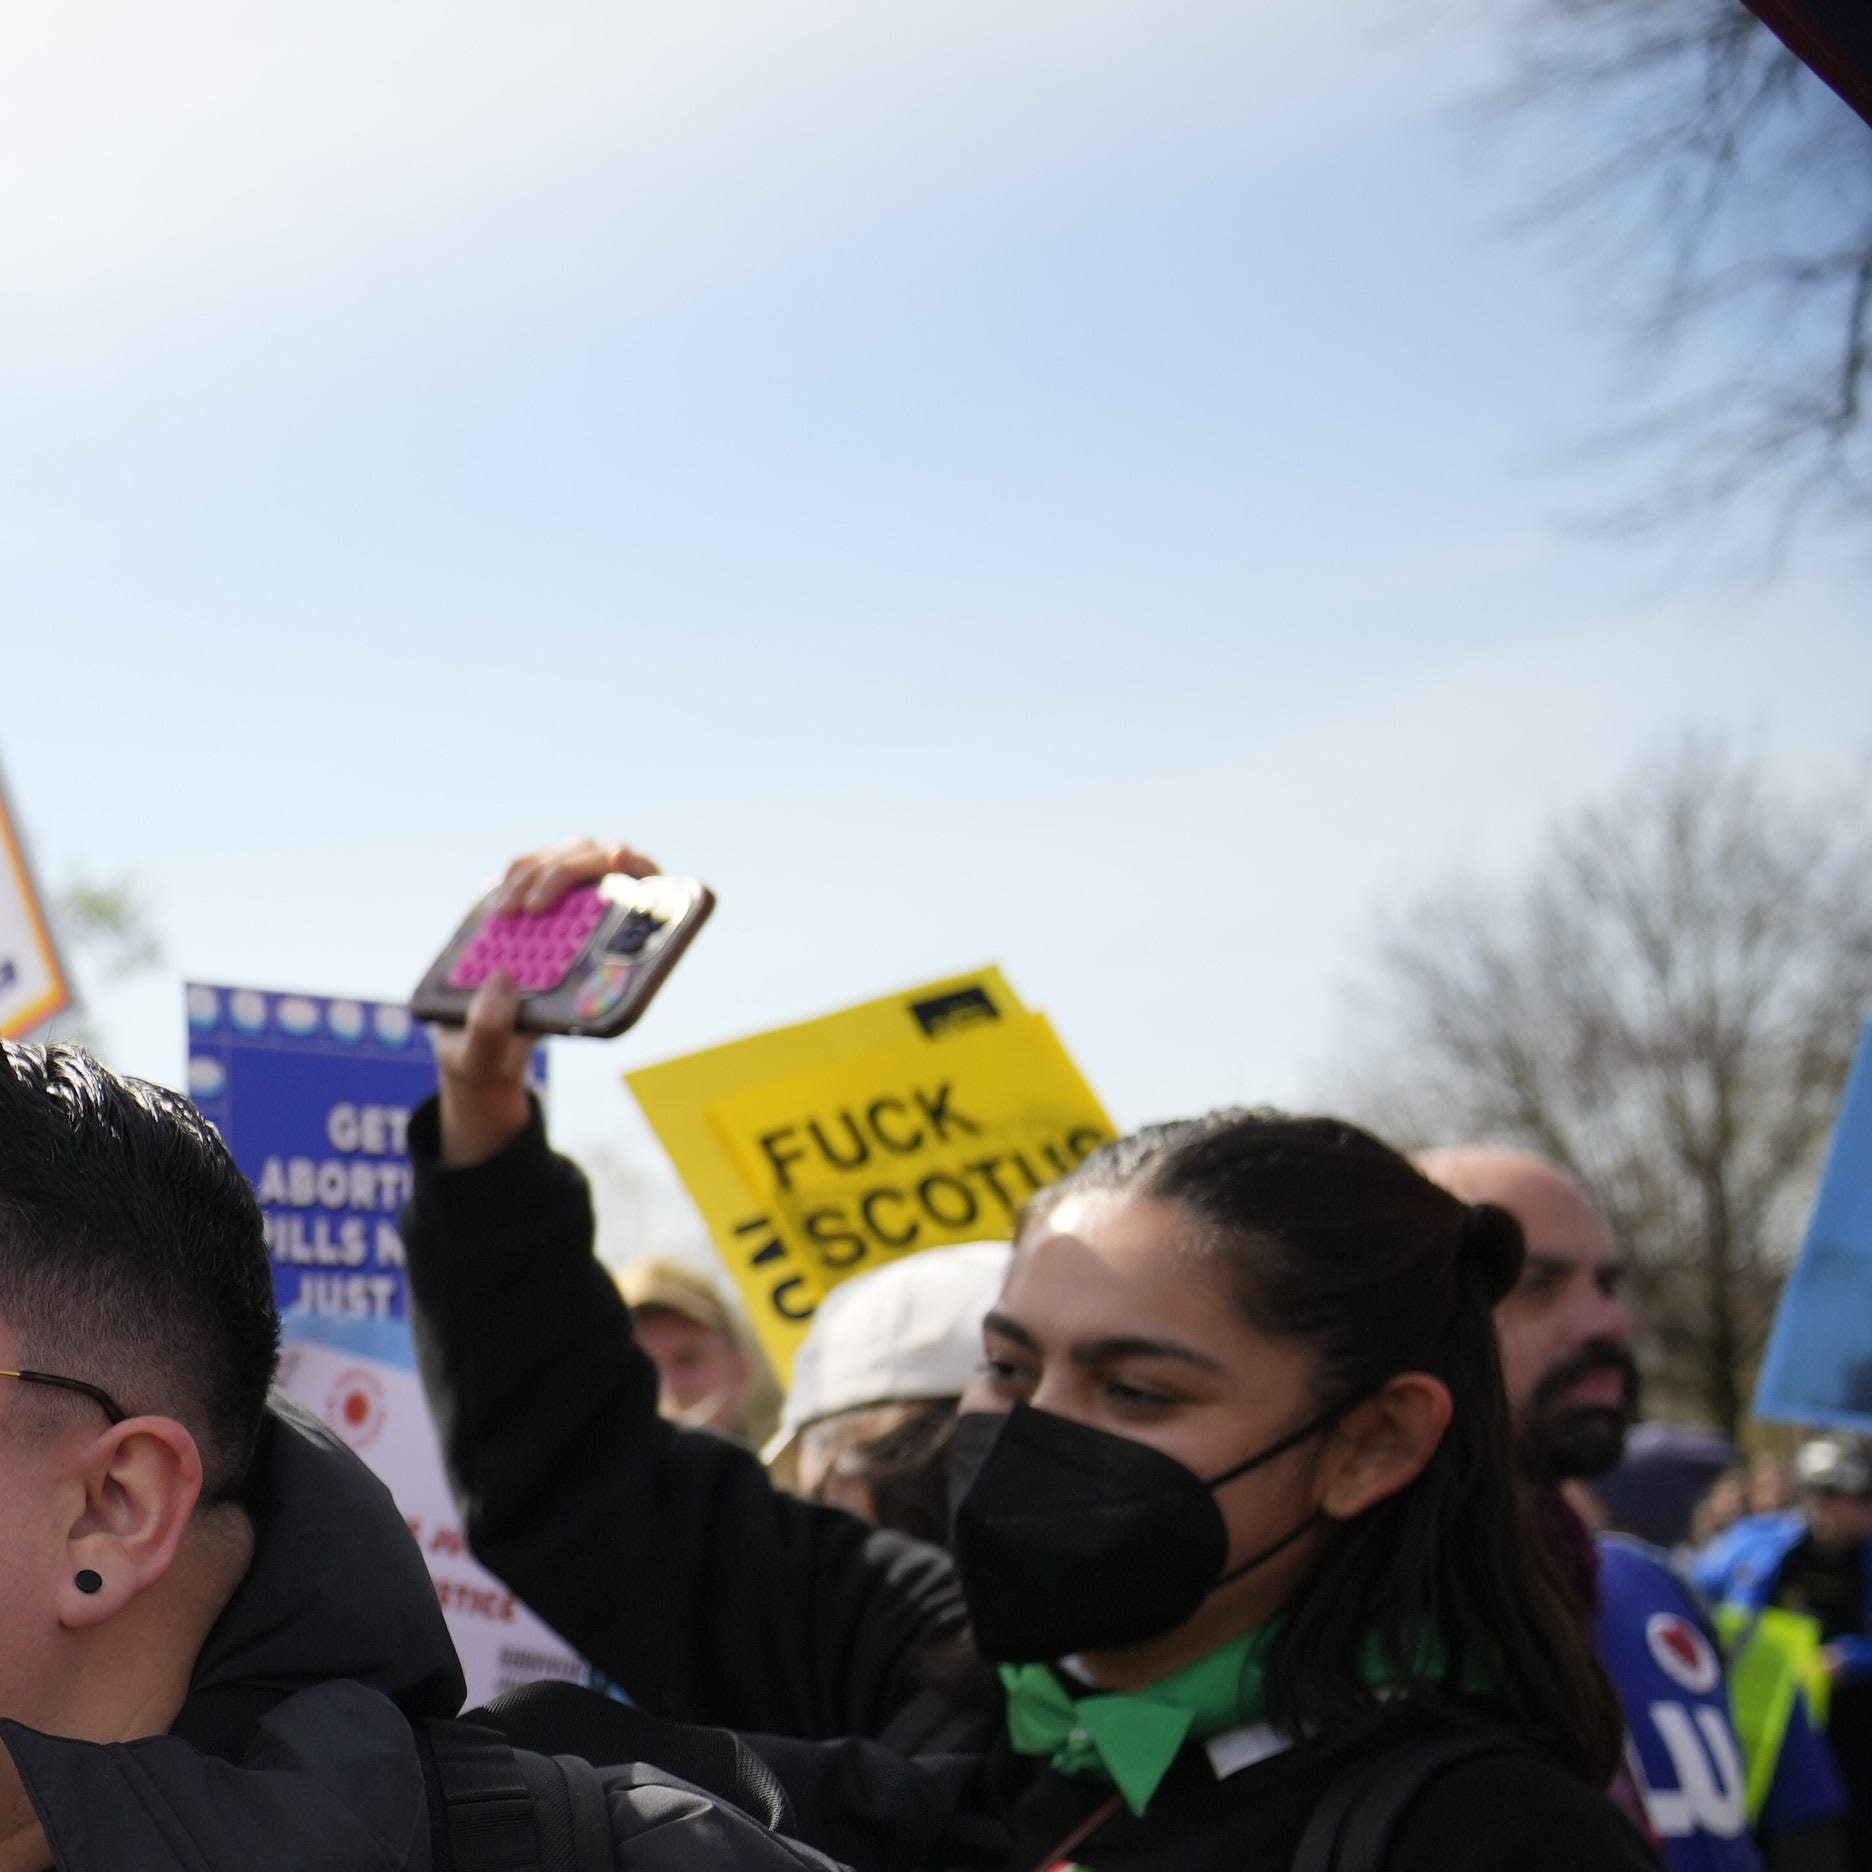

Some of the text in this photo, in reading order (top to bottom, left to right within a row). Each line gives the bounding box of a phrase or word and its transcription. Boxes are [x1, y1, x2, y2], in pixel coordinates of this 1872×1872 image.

[328, 1102, 408, 1155] GET
[759, 1080, 982, 1192] FUCK
[259, 1156, 413, 1209] ABORTI
[264, 1214, 373, 1268] ILLS
[296, 1271, 399, 1319] JUST
